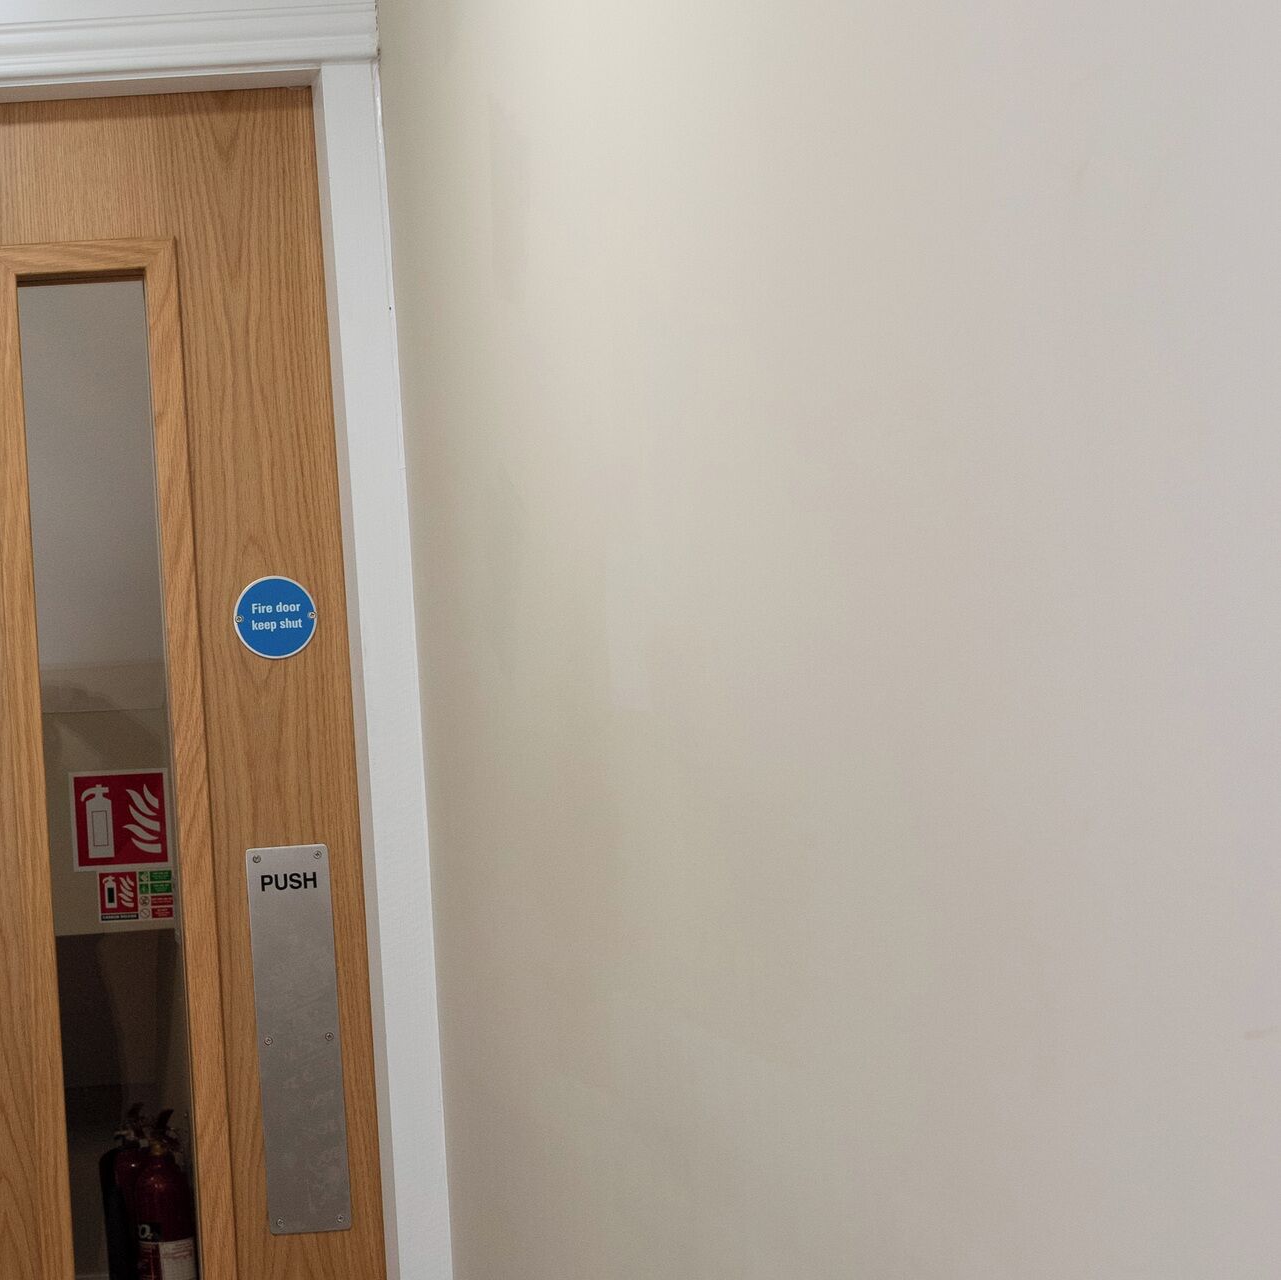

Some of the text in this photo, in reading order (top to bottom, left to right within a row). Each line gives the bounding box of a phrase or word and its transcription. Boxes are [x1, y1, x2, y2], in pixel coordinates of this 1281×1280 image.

[251, 601, 301, 614] Fire door
[251, 617, 303, 632] keep shut
[260, 871, 318, 892] PUSH
